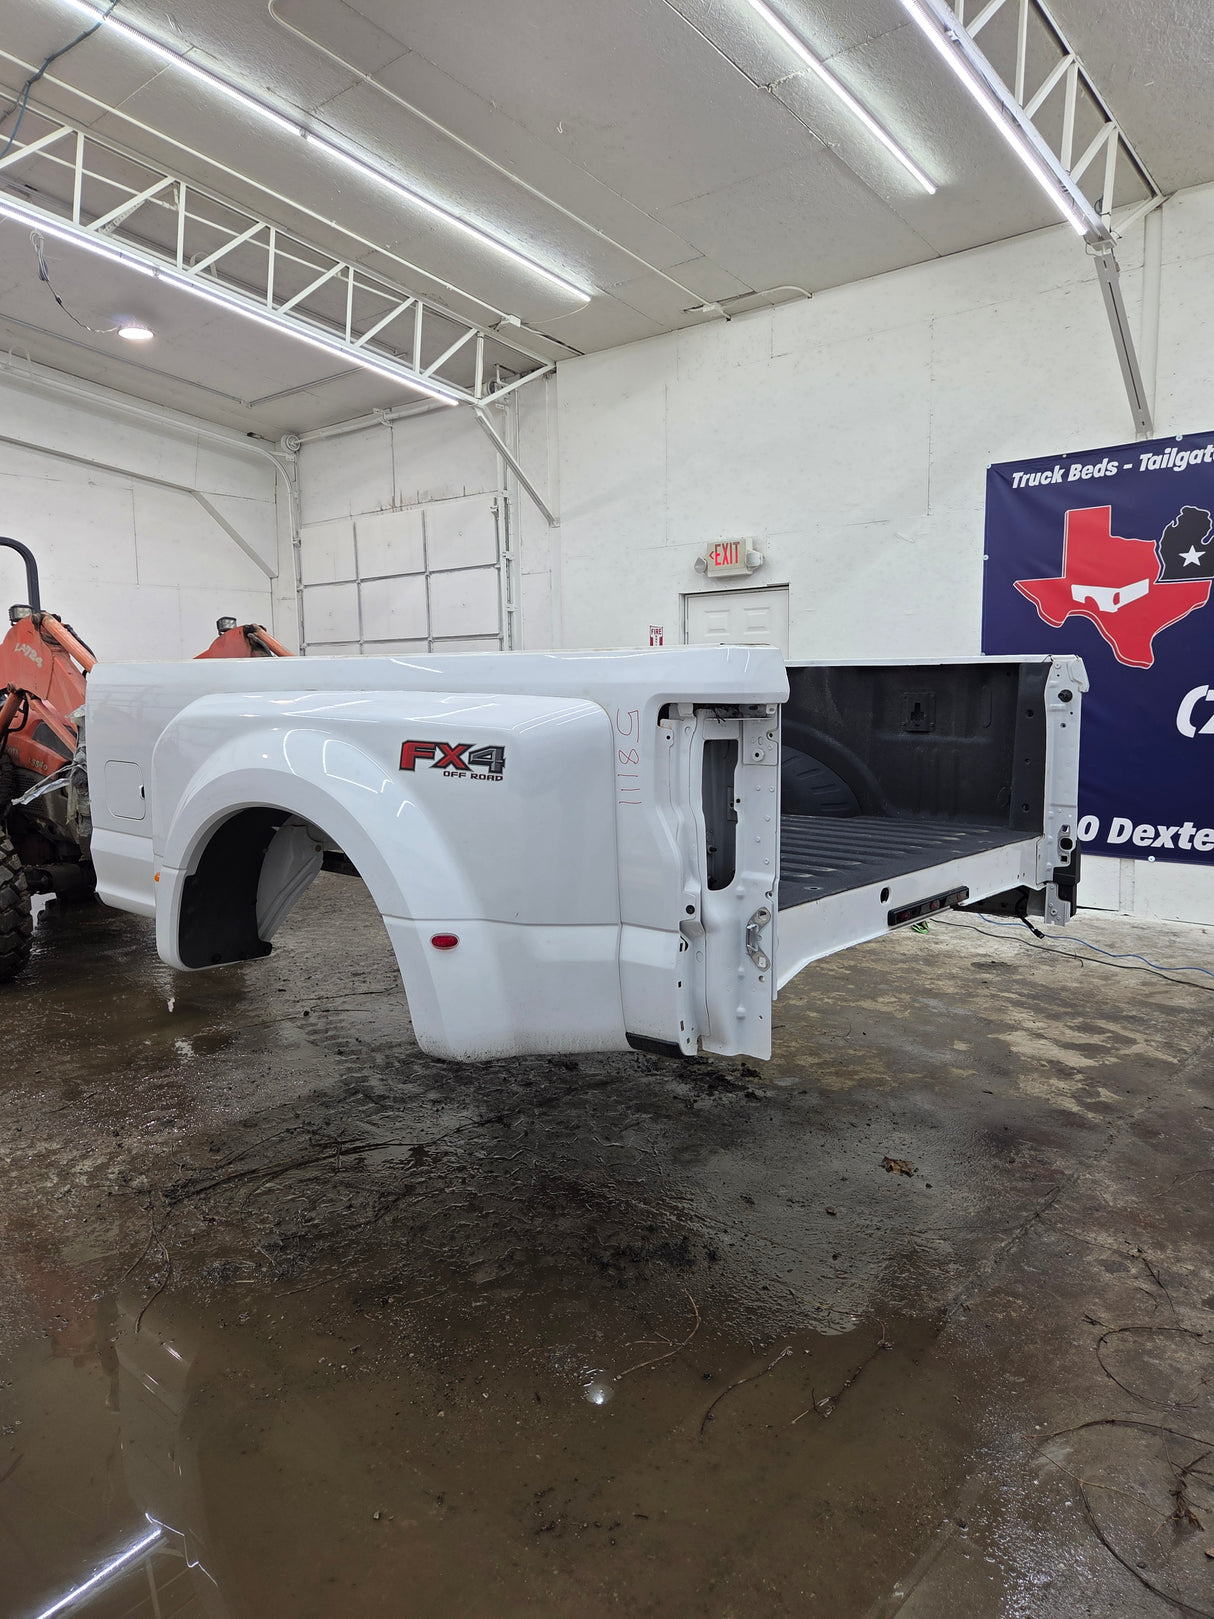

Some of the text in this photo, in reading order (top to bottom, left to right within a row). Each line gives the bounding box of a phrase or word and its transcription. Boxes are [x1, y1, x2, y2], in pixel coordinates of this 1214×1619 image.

[1012, 465, 1065, 488] Truck
[1067, 458, 1118, 482] Beds
[1139, 444, 1214, 472] Tailgat
[714, 541, 740, 566] EXIT
[399, 739, 506, 774] FX4
[443, 770, 504, 782] OFF ROAD
